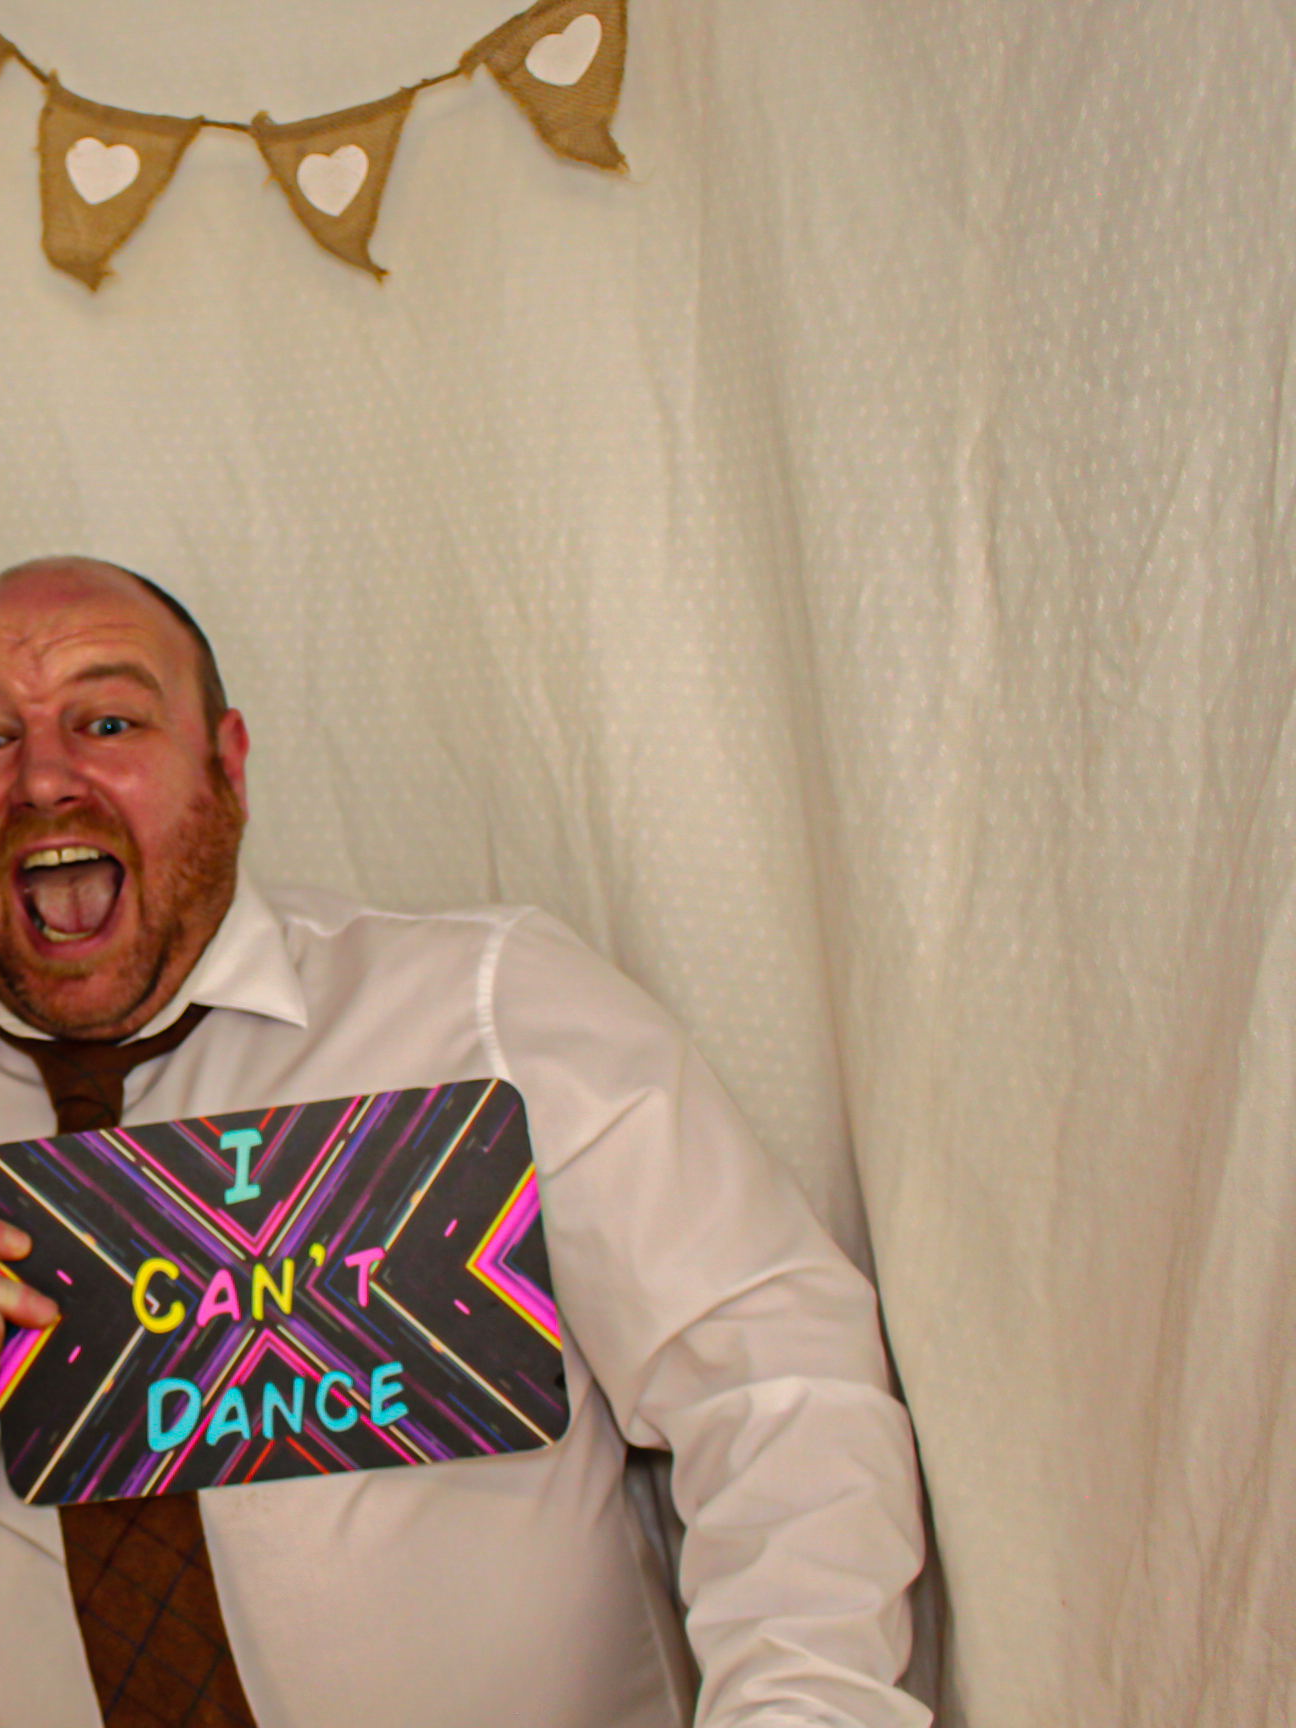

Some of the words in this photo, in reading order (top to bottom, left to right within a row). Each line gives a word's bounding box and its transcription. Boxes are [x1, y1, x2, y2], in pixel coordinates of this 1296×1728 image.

[220, 1128, 262, 1204] I
[133, 1244, 386, 1333] CAN'T
[148, 1362, 408, 1452] DANCE
